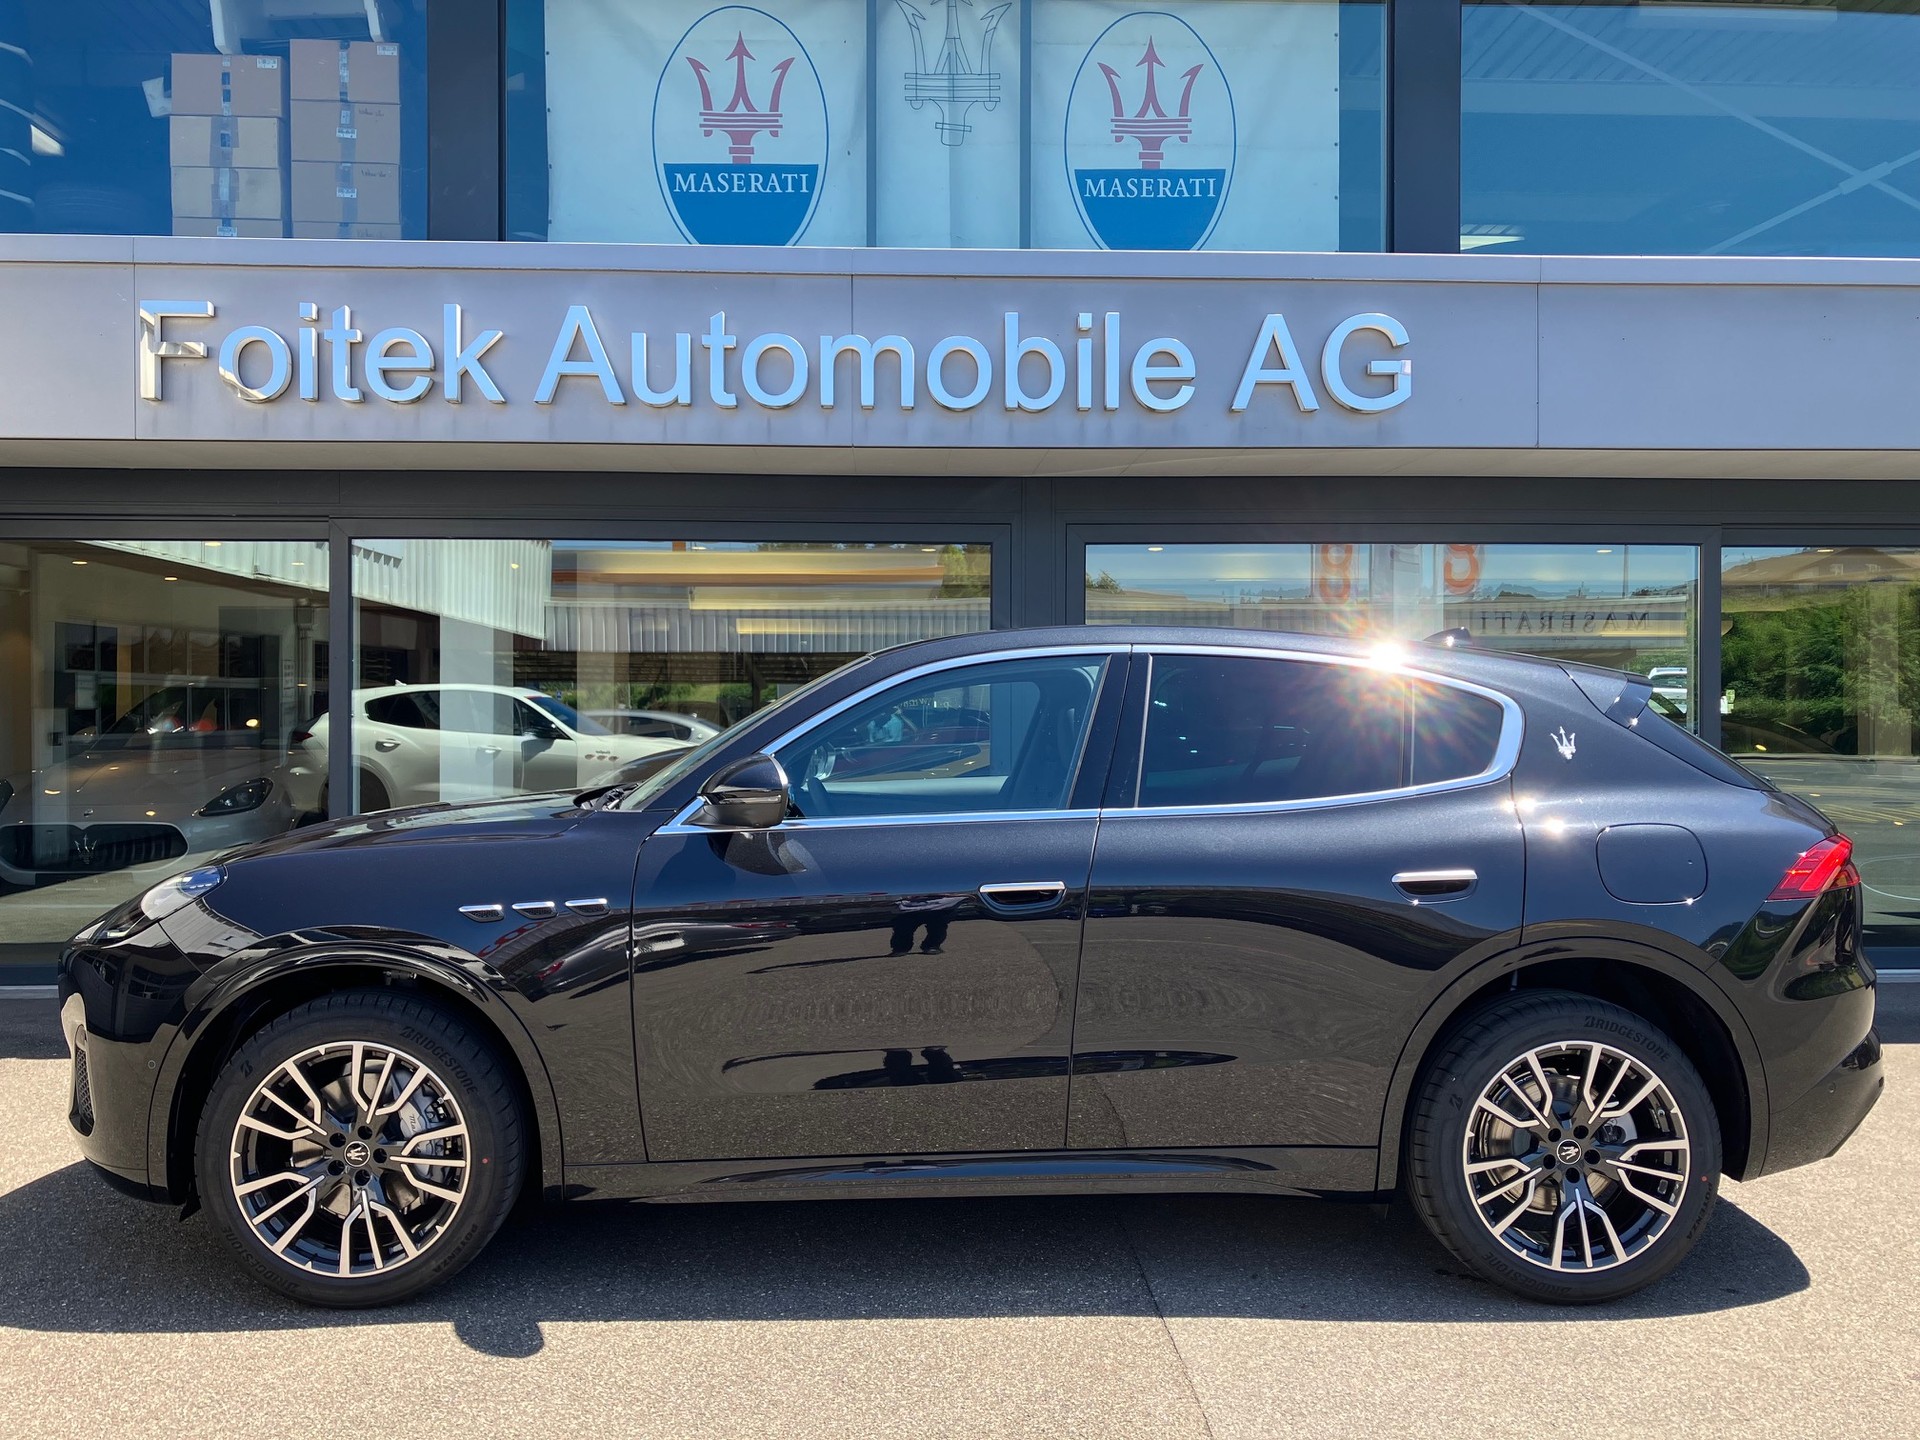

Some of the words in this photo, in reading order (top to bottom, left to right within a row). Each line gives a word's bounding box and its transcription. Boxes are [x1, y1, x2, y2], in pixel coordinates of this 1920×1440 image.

[673, 172, 809, 193] MASERATI
[1083, 177, 1217, 198] MASERATI
[139, 299, 507, 404] Foitek
[532, 304, 1196, 414] Automobile
[1229, 311, 1413, 415] AG
[400, 1025, 479, 1095] BRIDGESTONE
[1583, 1014, 1672, 1063] BRIDGESTONE
